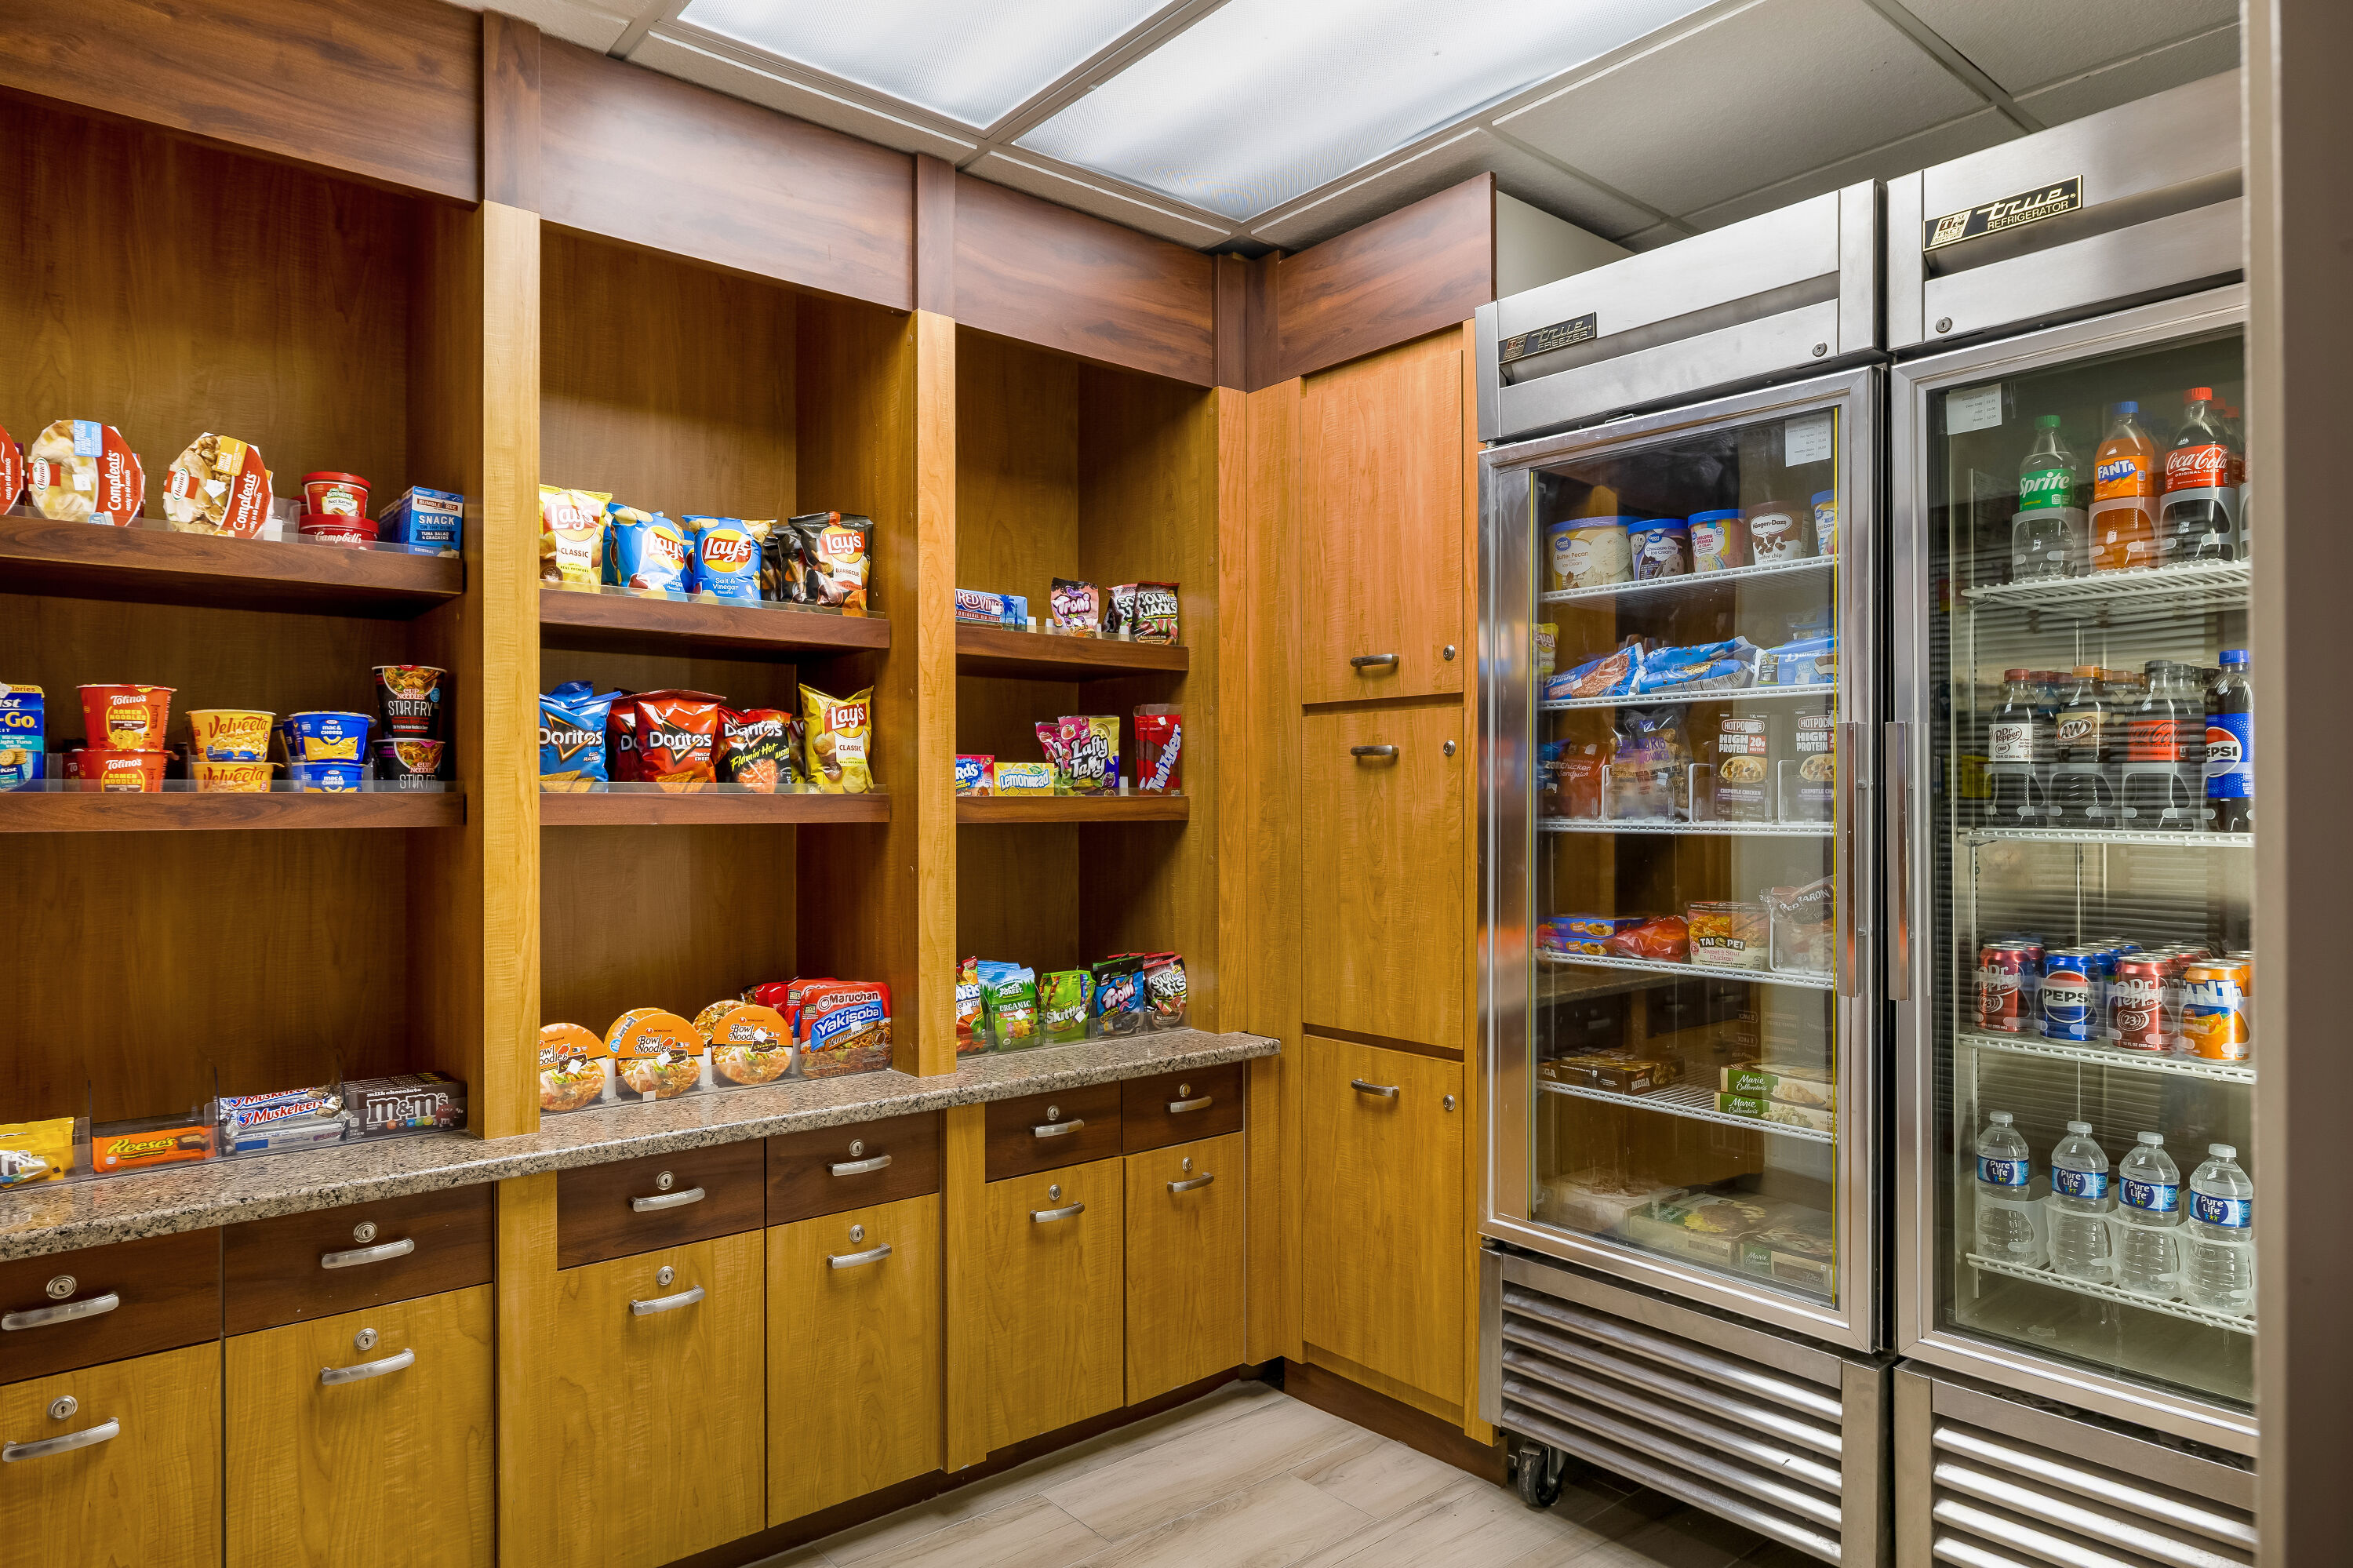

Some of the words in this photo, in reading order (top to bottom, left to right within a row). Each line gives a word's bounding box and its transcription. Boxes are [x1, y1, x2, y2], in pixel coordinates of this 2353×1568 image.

[1988, 200, 2068, 231] REFRIGERATOR
[1537, 331, 1587, 351] FREEZER
[2166, 447, 2228, 475] Coca-Cola
[2097, 459, 2137, 478] FANTA
[105, 452, 124, 511] Compleats
[174, 472, 186, 496] Hormel
[2020, 471, 2070, 498] Sprite
[233, 474, 256, 531] Compleats
[419, 499, 442, 508] BUMBLE
[418, 515, 455, 525] SNACK
[551, 503, 596, 531] Lay's
[315, 531, 362, 544] Campbell's
[826, 532, 864, 555] Lay's
[560, 548, 589, 558] CLASSIC
[650, 533, 684, 562] Lay's
[704, 536, 751, 563] Lay's
[835, 567, 860, 577] BARBECUE
[712, 583, 739, 592] Vinegar
[957, 590, 979, 606] RED
[1054, 593, 1090, 614] Trolli
[1144, 603, 1176, 617] JACKS
[111, 695, 147, 706] Totino's
[388, 700, 411, 716] STIR
[413, 701, 433, 716] FRY
[831, 703, 865, 730] Lay's
[209, 715, 269, 738] Velveeta
[725, 720, 784, 737] Doritos
[2060, 720, 2085, 739] A&W
[540, 728, 602, 745] Doritos
[650, 731, 712, 748] Doritos
[1719, 734, 1749, 744] HIGH
[1750, 737, 1765, 748] 20g
[1795, 732, 1827, 742] HIGH
[1995, 729, 2020, 743] Pepper
[761, 742, 779, 755] Hot
[1071, 736, 1107, 759] Laffy
[1718, 744, 1748, 753] PROTEIN
[1796, 742, 1828, 751] PROTEIN
[105, 759, 142, 770] Totino's
[1070, 755, 1106, 778] Taffy
[1561, 762, 1591, 771] Chicken
[203, 766, 267, 789] Velveeta
[399, 774, 424, 789] STIR
[1780, 903, 1799, 911] RED
[1797, 889, 1830, 904] BARON
[1727, 939, 1744, 949] PEI
[1988, 964, 2009, 977] Dr
[2129, 978, 2153, 991] Dr
[830, 991, 878, 1004] Maruchan
[998, 988, 1024, 998] FOREST
[1103, 977, 1135, 1010] Trolli
[957, 999, 980, 1010] CANDY
[999, 1000, 1031, 1012] ORGANIC
[1045, 1003, 1086, 1024] Skittles
[2124, 1015, 2137, 1025] 23
[816, 1006, 879, 1036] Yakisoba
[637, 1035, 661, 1045] Bowl
[540, 1045, 555, 1057] owl
[635, 1044, 671, 1054] Noodles
[540, 1053, 568, 1065] oodles
[1631, 1077, 1650, 1092] MEGA
[1737, 1075, 1766, 1085] Marie
[366, 1093, 449, 1125] m&m's
[1729, 1097, 1757, 1108] Marie
[238, 1111, 253, 1127] 3
[253, 1100, 324, 1124] Musketeers
[1728, 1106, 1758, 1115] Callender's
[107, 1137, 177, 1155] Reese's
[1990, 1160, 2010, 1170] Pure
[1992, 1167, 2008, 1177] Life
[2060, 1170, 2081, 1181] Pure
[2063, 1177, 2078, 1188] Life
[2129, 1181, 2150, 1192] Pure
[2130, 1188, 2148, 1200] Life
[2201, 1195, 2224, 1208] Pure
[2202, 1204, 2220, 1215] Life
